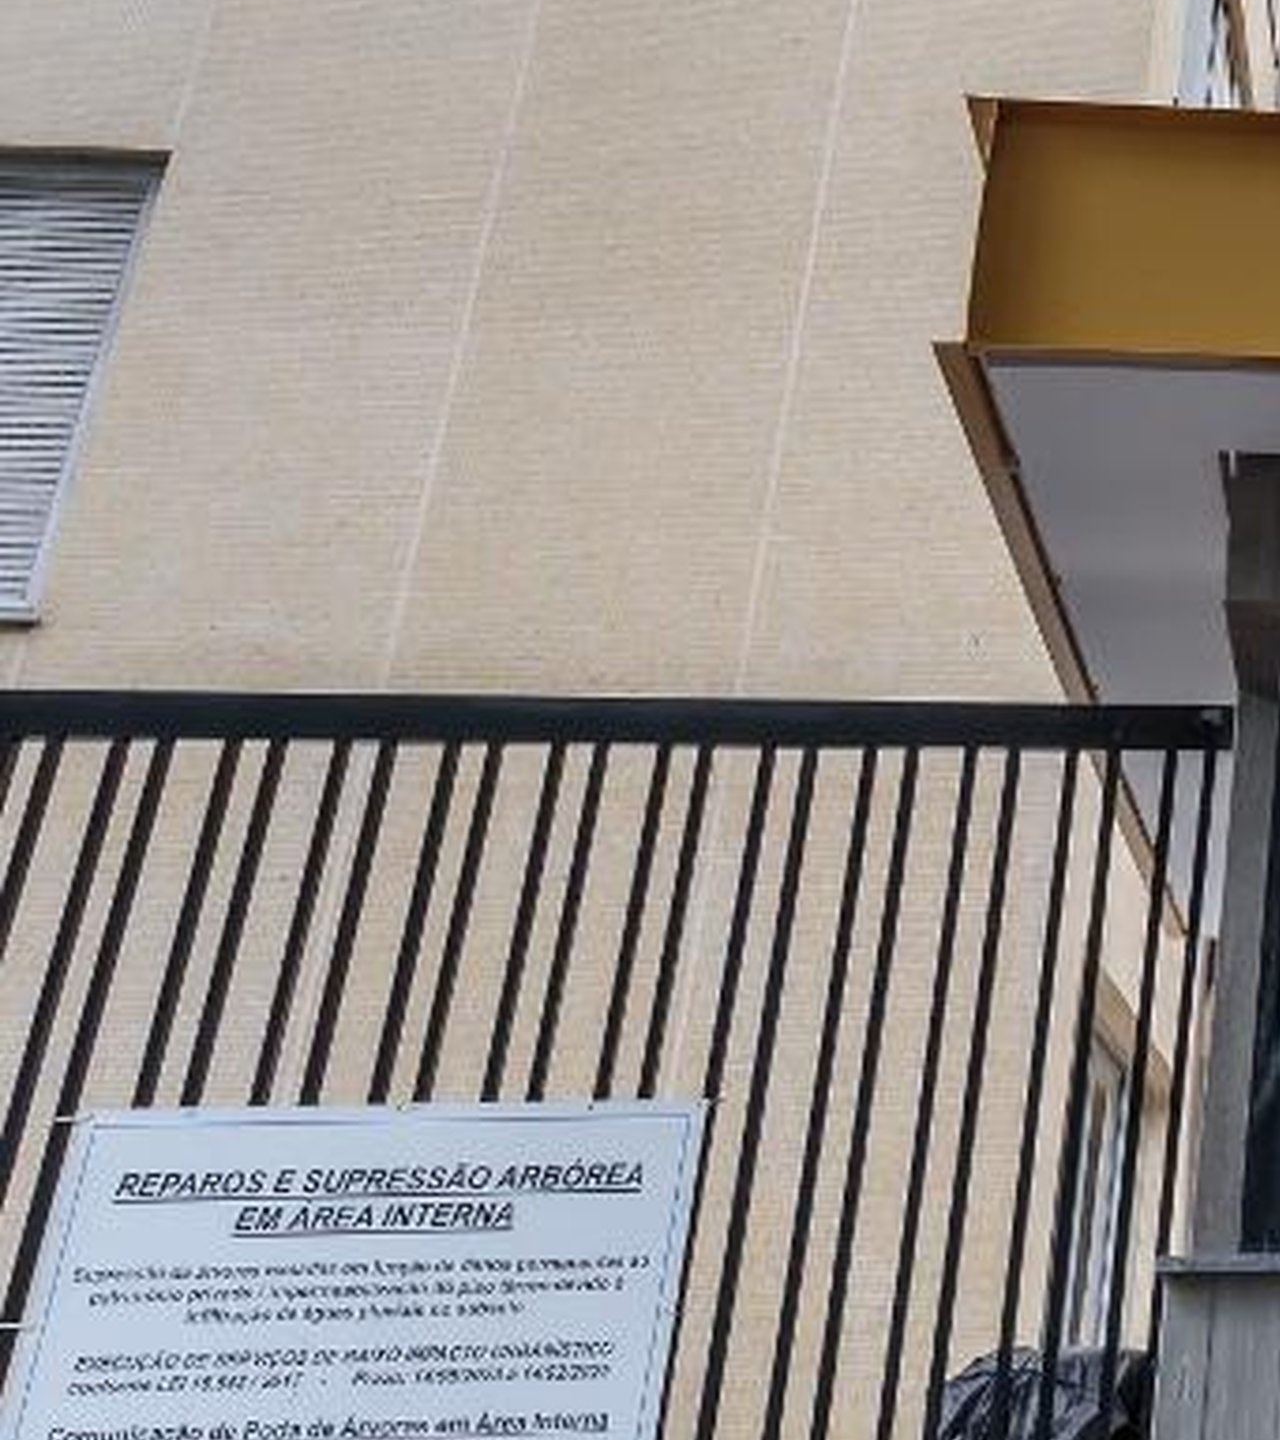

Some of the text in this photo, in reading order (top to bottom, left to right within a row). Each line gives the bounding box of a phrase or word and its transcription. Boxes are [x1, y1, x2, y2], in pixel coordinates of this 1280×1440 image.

[115, 1158, 643, 1198] REPAROS E SUPRESSÃO ARBÓREA
[234, 1206, 284, 1231] EM
[380, 1201, 514, 1228] INTERNA
